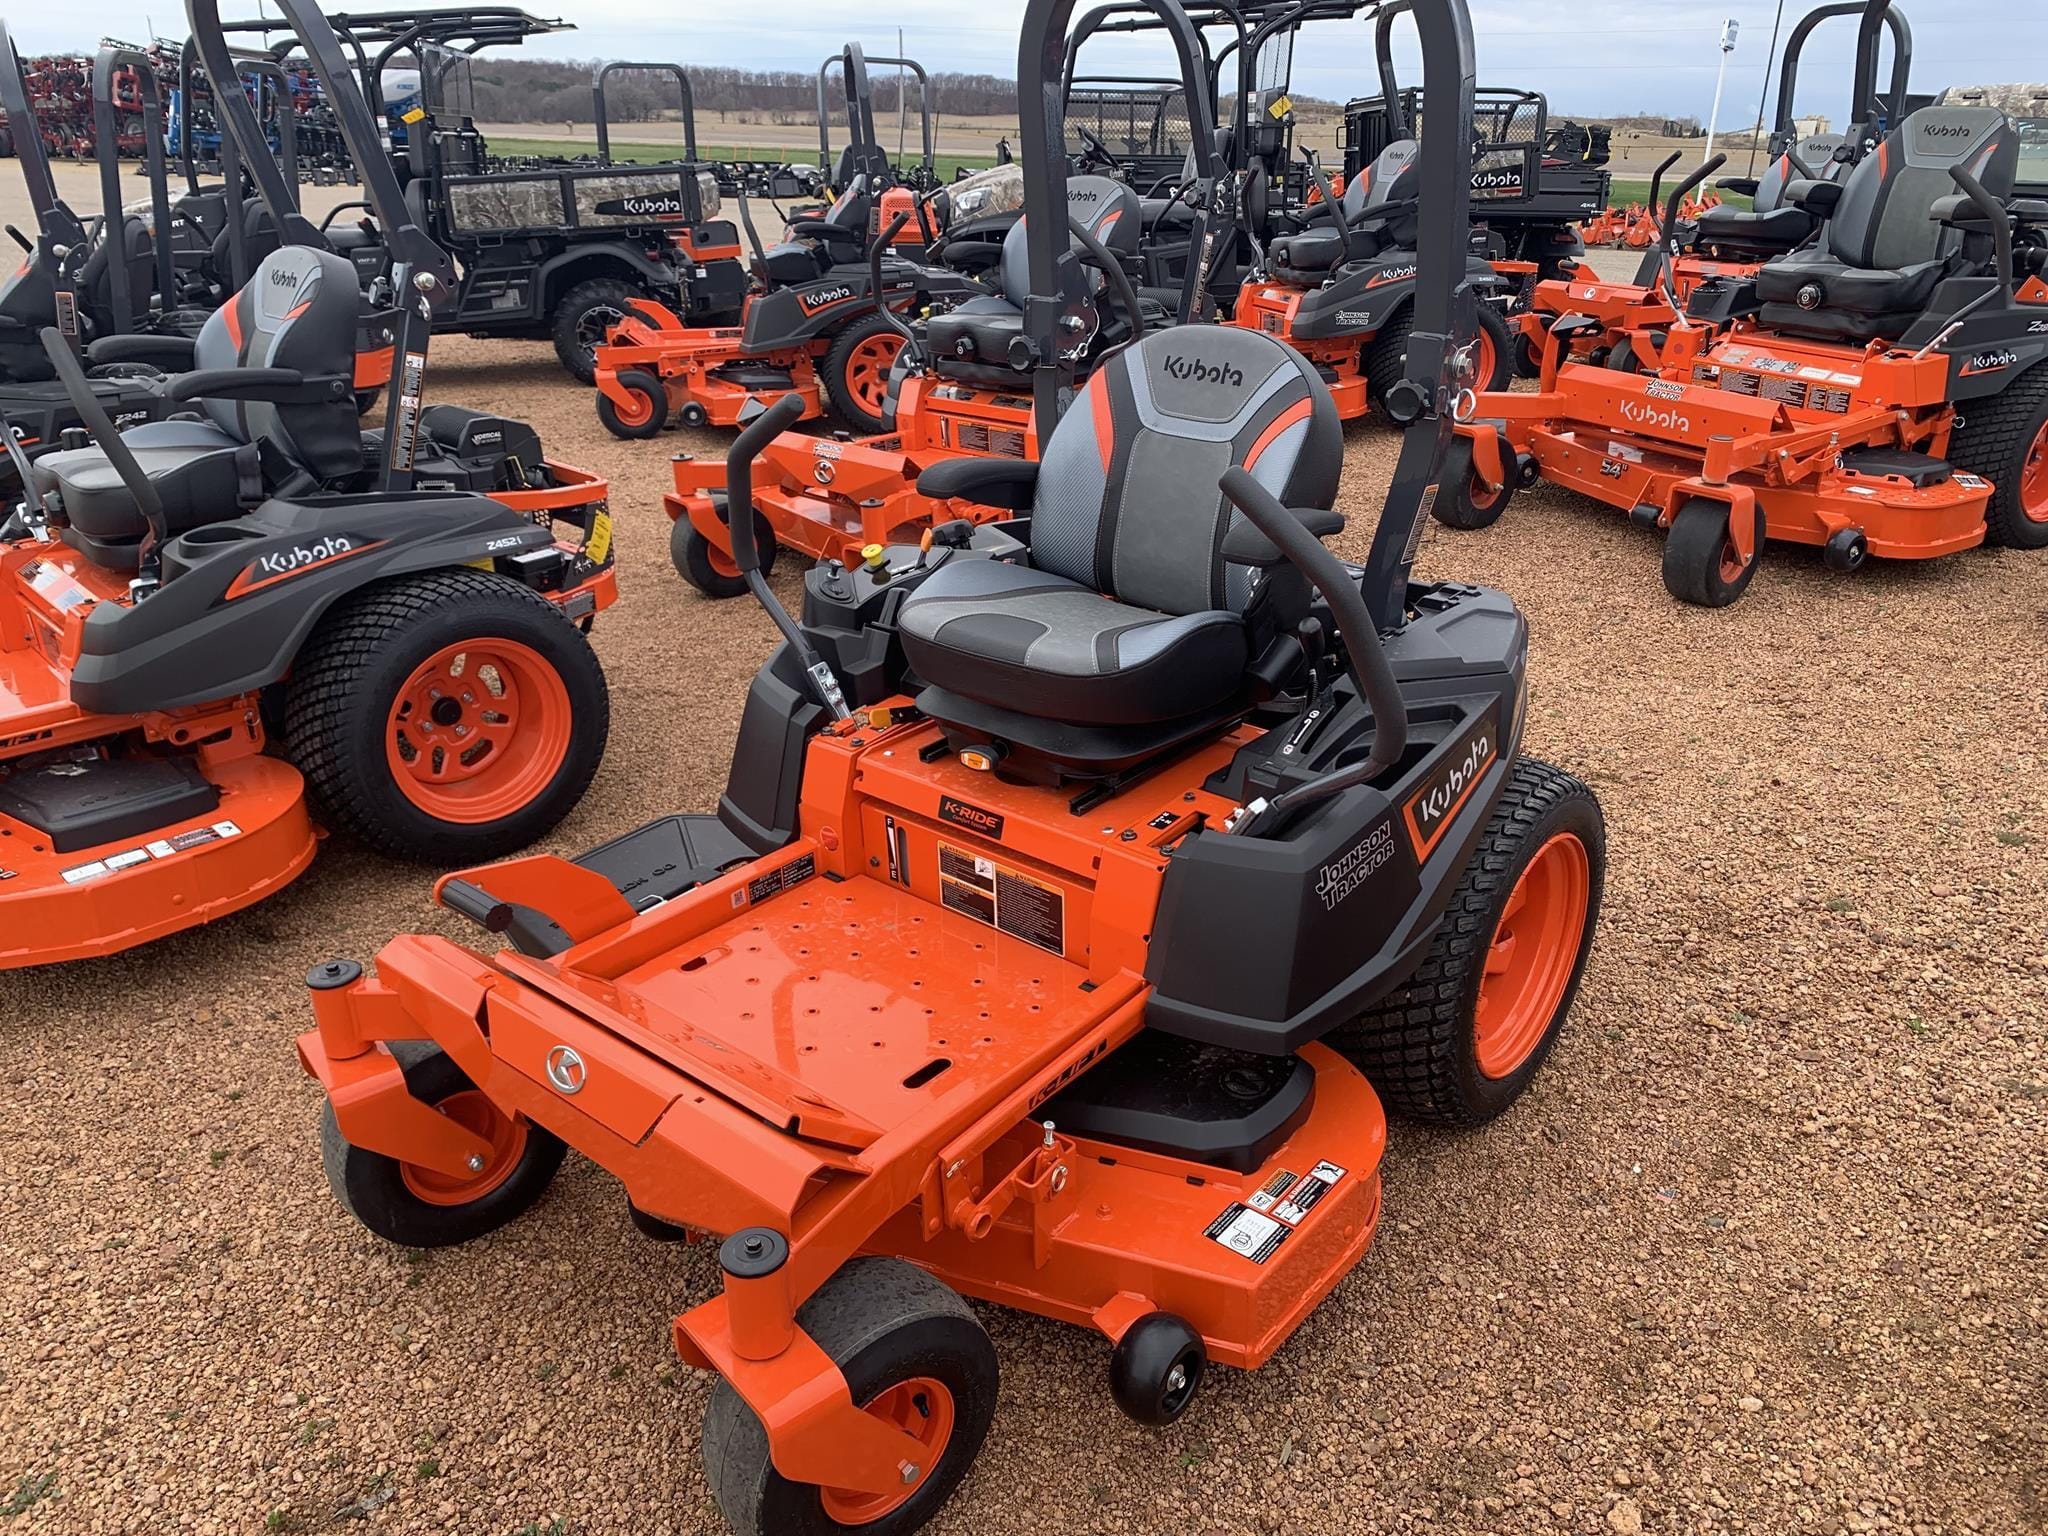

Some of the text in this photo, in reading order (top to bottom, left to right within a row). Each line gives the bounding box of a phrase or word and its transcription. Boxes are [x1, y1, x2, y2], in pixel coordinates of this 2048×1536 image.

[1924, 124, 1970, 137] Kubota
[1809, 143, 1832, 152] Kubota
[623, 198, 681, 214] Kubota
[806, 287, 850, 305] Kubota
[1973, 351, 2017, 368] Kubota
[1163, 355, 1243, 387] Kubota
[1645, 386, 1681, 401] TRACTOR
[1648, 379, 1686, 393] JOHNSON
[115, 410, 147, 425] Z242
[1620, 399, 1690, 432] Kubota
[260, 537, 352, 573] Kubota
[1421, 736, 1489, 822] Kubota
[887, 818, 893, 826] F
[1315, 819, 1391, 894] JOHNSON
[891, 870, 897, 879] E
[1320, 839, 1395, 911] TRACTOR
